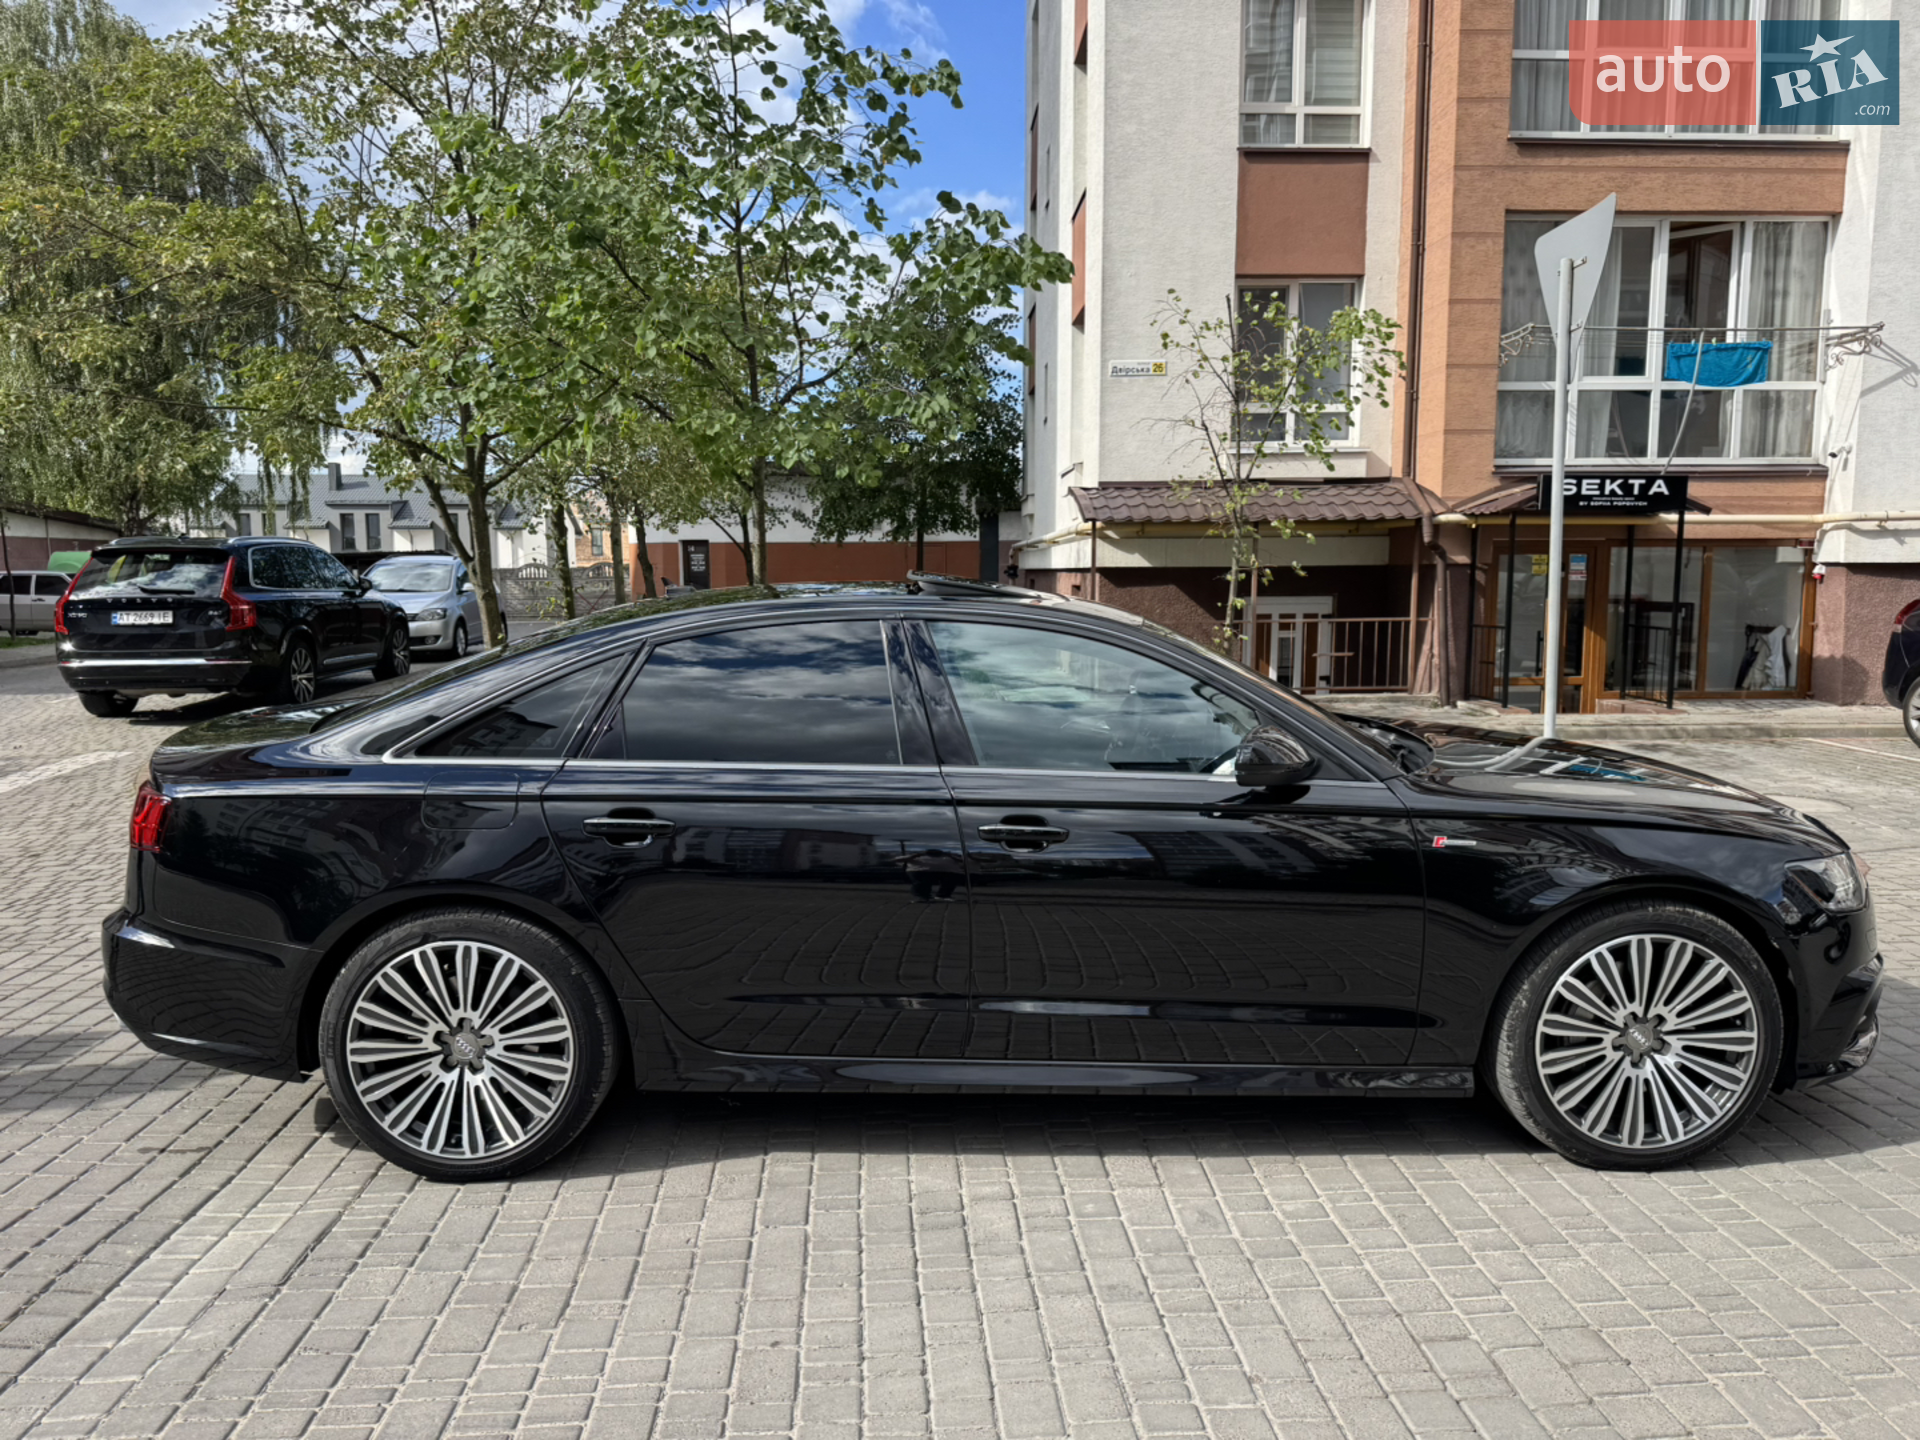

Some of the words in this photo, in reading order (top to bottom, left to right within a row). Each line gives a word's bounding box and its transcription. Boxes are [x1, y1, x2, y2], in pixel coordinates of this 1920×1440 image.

[1111, 365, 1151, 375] Двірська
[1562, 478, 1670, 496] SEKTA
[118, 612, 131, 621] AT
[132, 612, 155, 621] 2669
